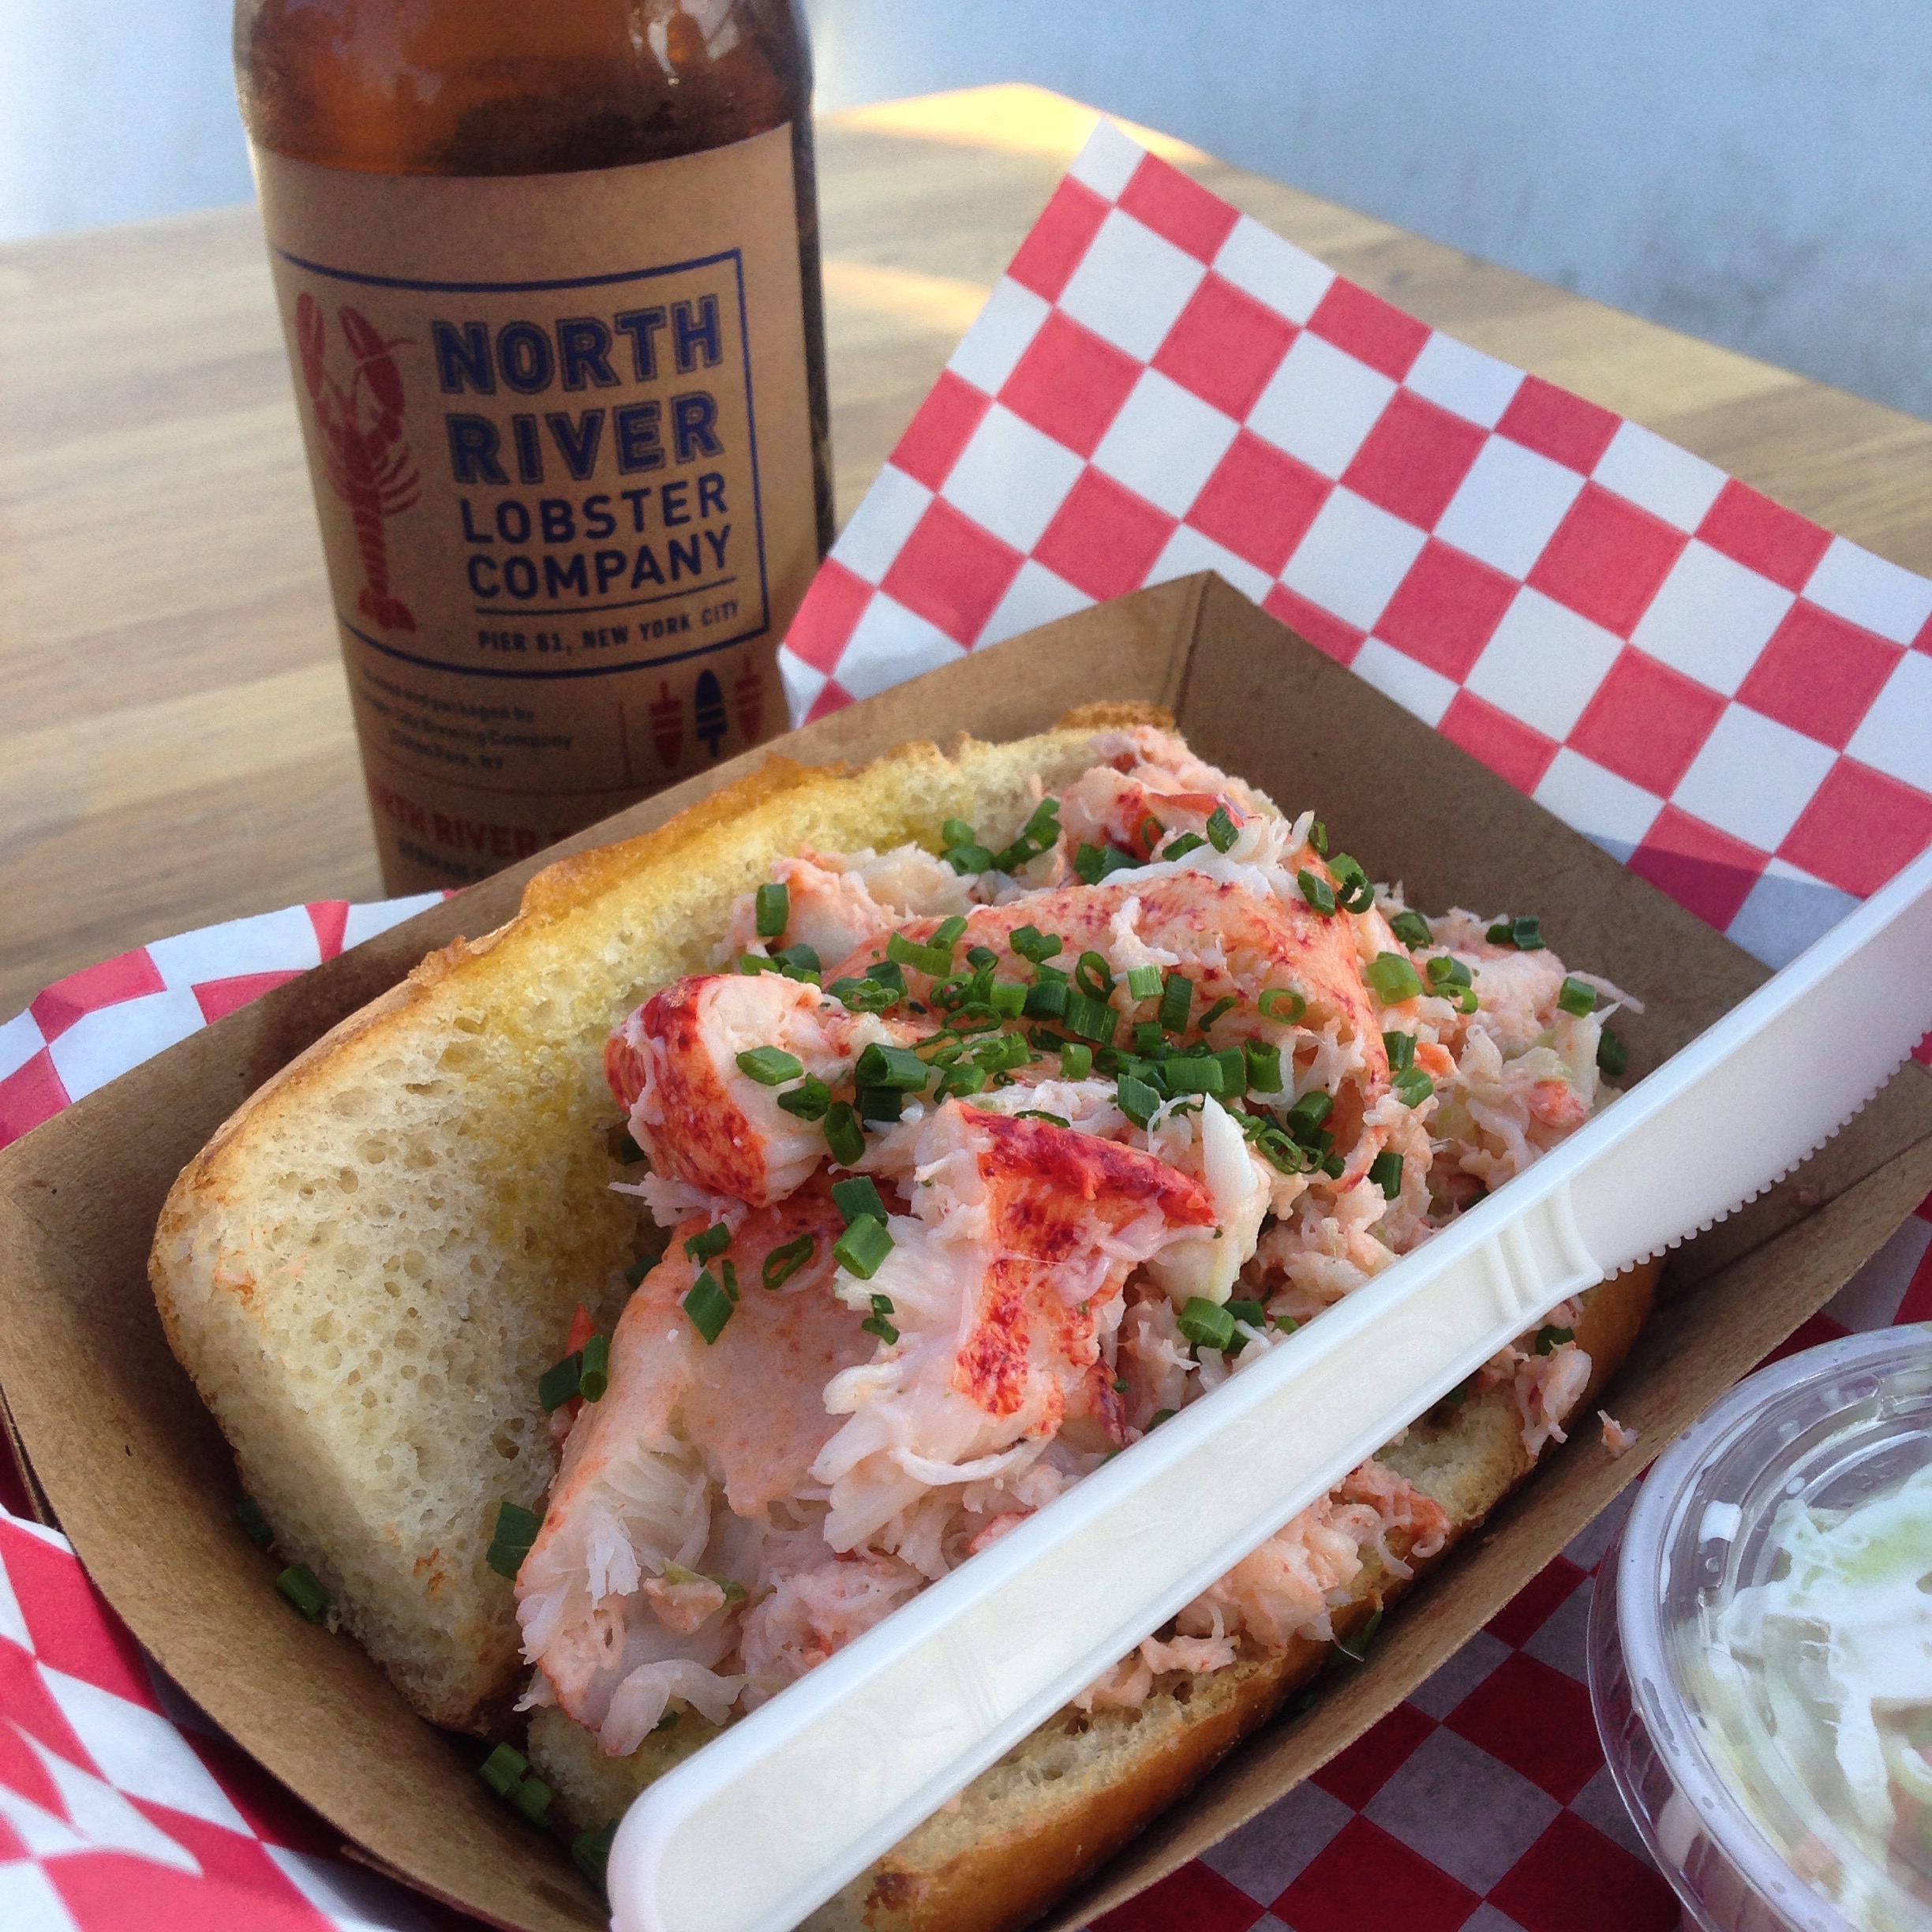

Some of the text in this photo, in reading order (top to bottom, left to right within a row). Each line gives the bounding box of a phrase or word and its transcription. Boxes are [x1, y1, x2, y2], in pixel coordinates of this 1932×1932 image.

[432, 293, 723, 395] NORTH
[445, 390, 724, 486] RIVER
[459, 471, 728, 545] LOBSTER
[468, 524, 732, 599] COMPANY
[478, 631, 527, 653] PIER
[582, 625, 629, 649] NEW
[638, 614, 692, 642] YORK
[701, 598, 739, 627] CITY
[432, 812, 537, 859] RIVER
